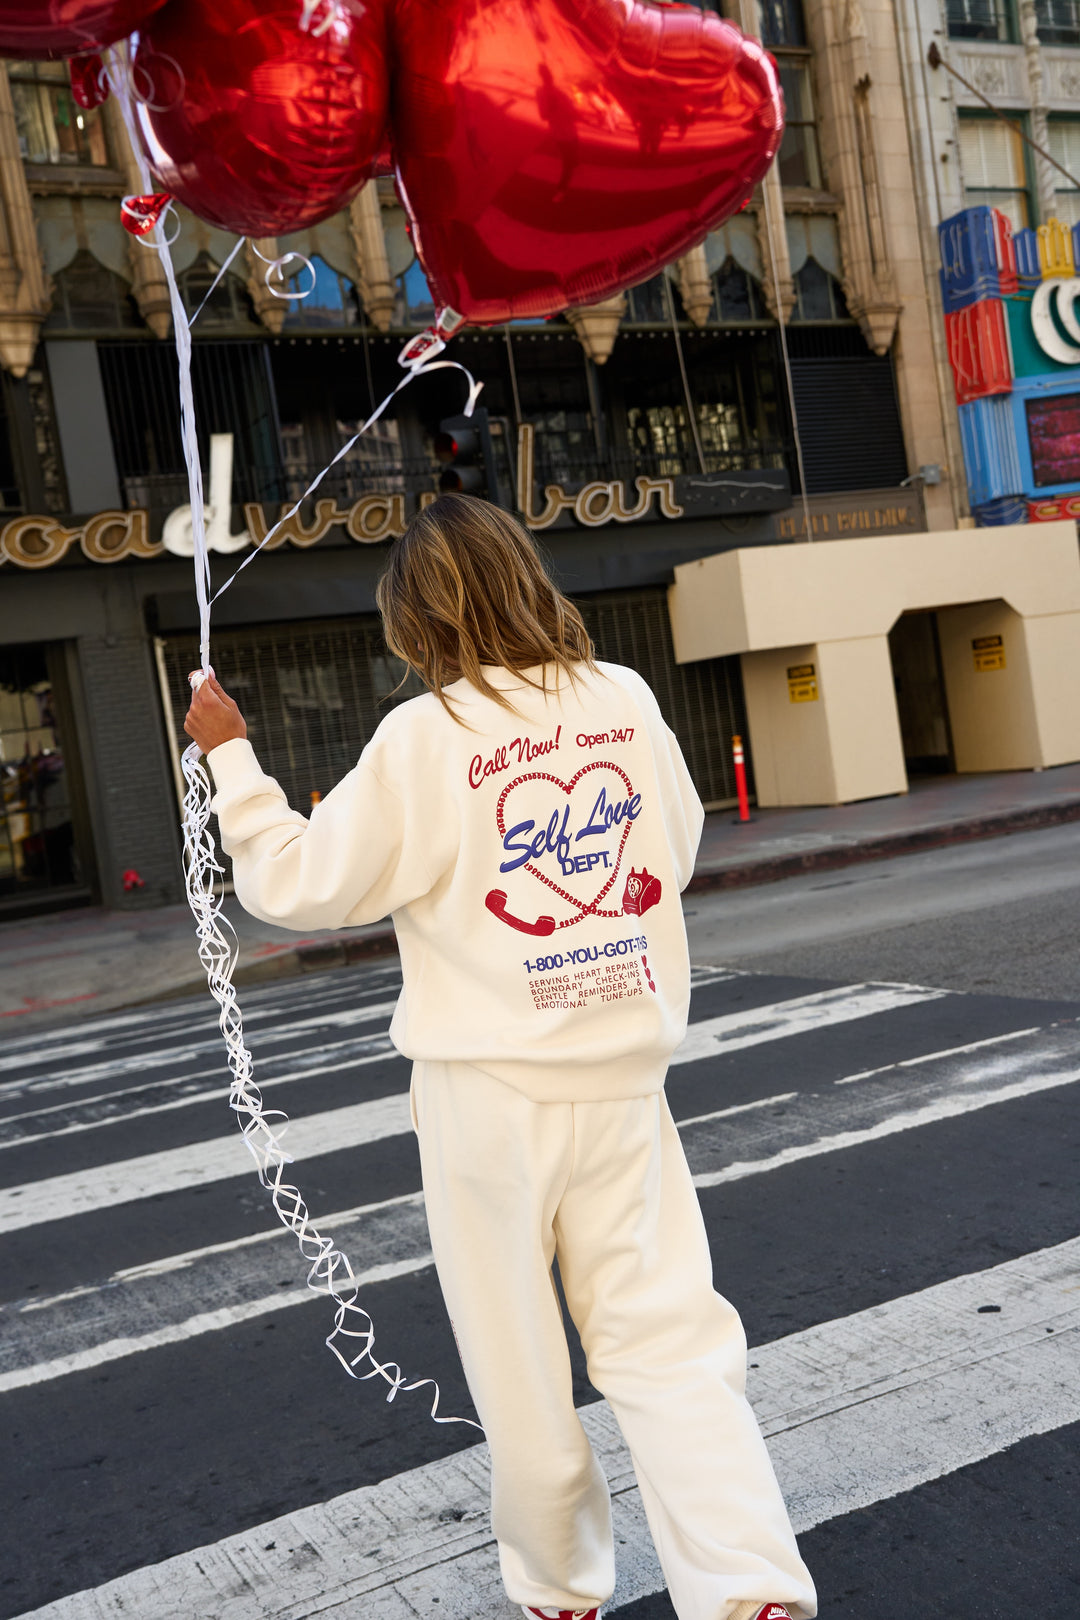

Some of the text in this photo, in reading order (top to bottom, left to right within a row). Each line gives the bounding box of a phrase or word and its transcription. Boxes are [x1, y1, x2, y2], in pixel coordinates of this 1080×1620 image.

[0, 422, 684, 570] oadwa bar
[576, 728, 635, 749] Open 24/7
[468, 725, 562, 790] Call Now!
[499, 786, 643, 873] Self Love
[561, 850, 613, 876] DEPT.
[529, 960, 639, 989] SERVING HEART REPAIRS
[531, 970, 640, 996] BOUNDARY CHECK-INS
[533, 978, 642, 1003] GENTLE REMINDERS &
[535, 987, 643, 1010] EMOTIONAL TUNE-UPS
